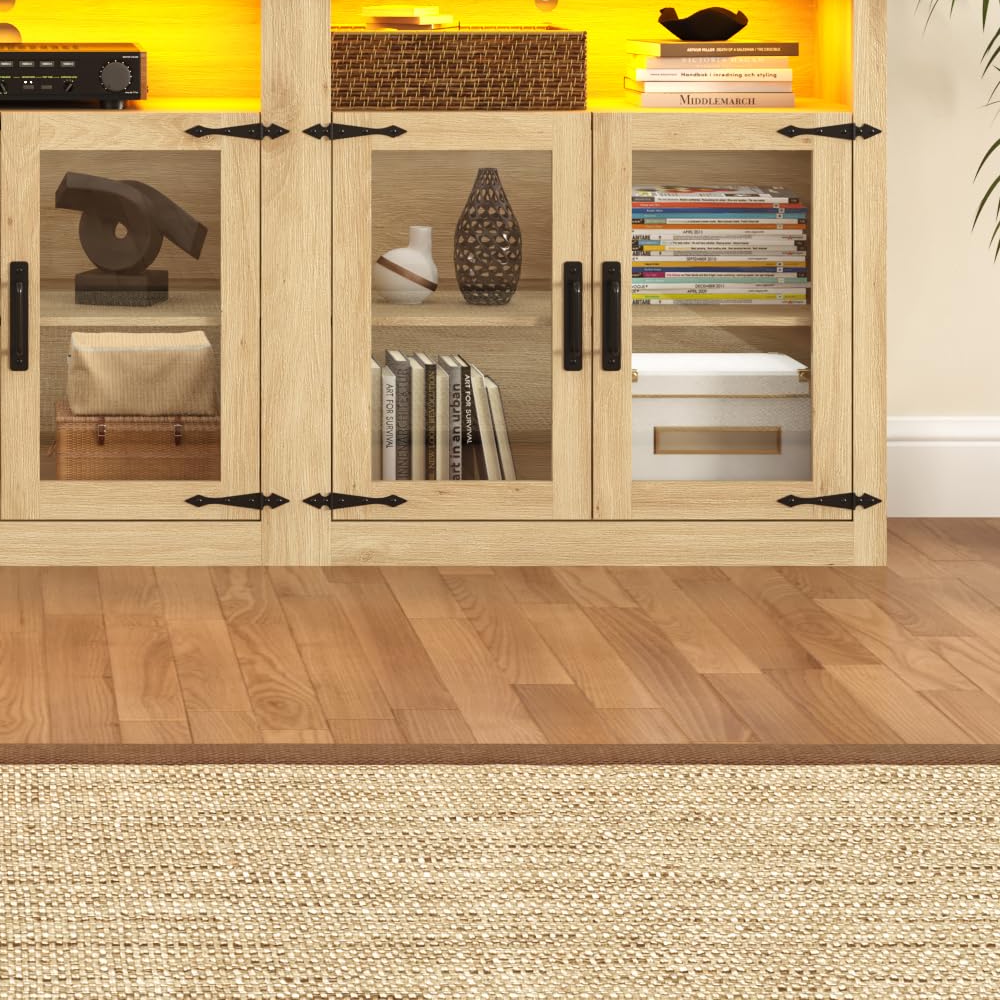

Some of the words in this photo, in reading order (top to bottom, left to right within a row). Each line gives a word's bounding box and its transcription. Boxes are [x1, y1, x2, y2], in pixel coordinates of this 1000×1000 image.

[680, 94, 756, 105] MIDDLEMARCH
[386, 384, 394, 396] ART
[386, 400, 394, 414] FOR
[449, 383, 461, 422] urban
[386, 416, 394, 449] SURVIVAL
[451, 426, 461, 442] an
[465, 409, 473, 444] SURVIVAL
[449, 446, 461, 458] in
